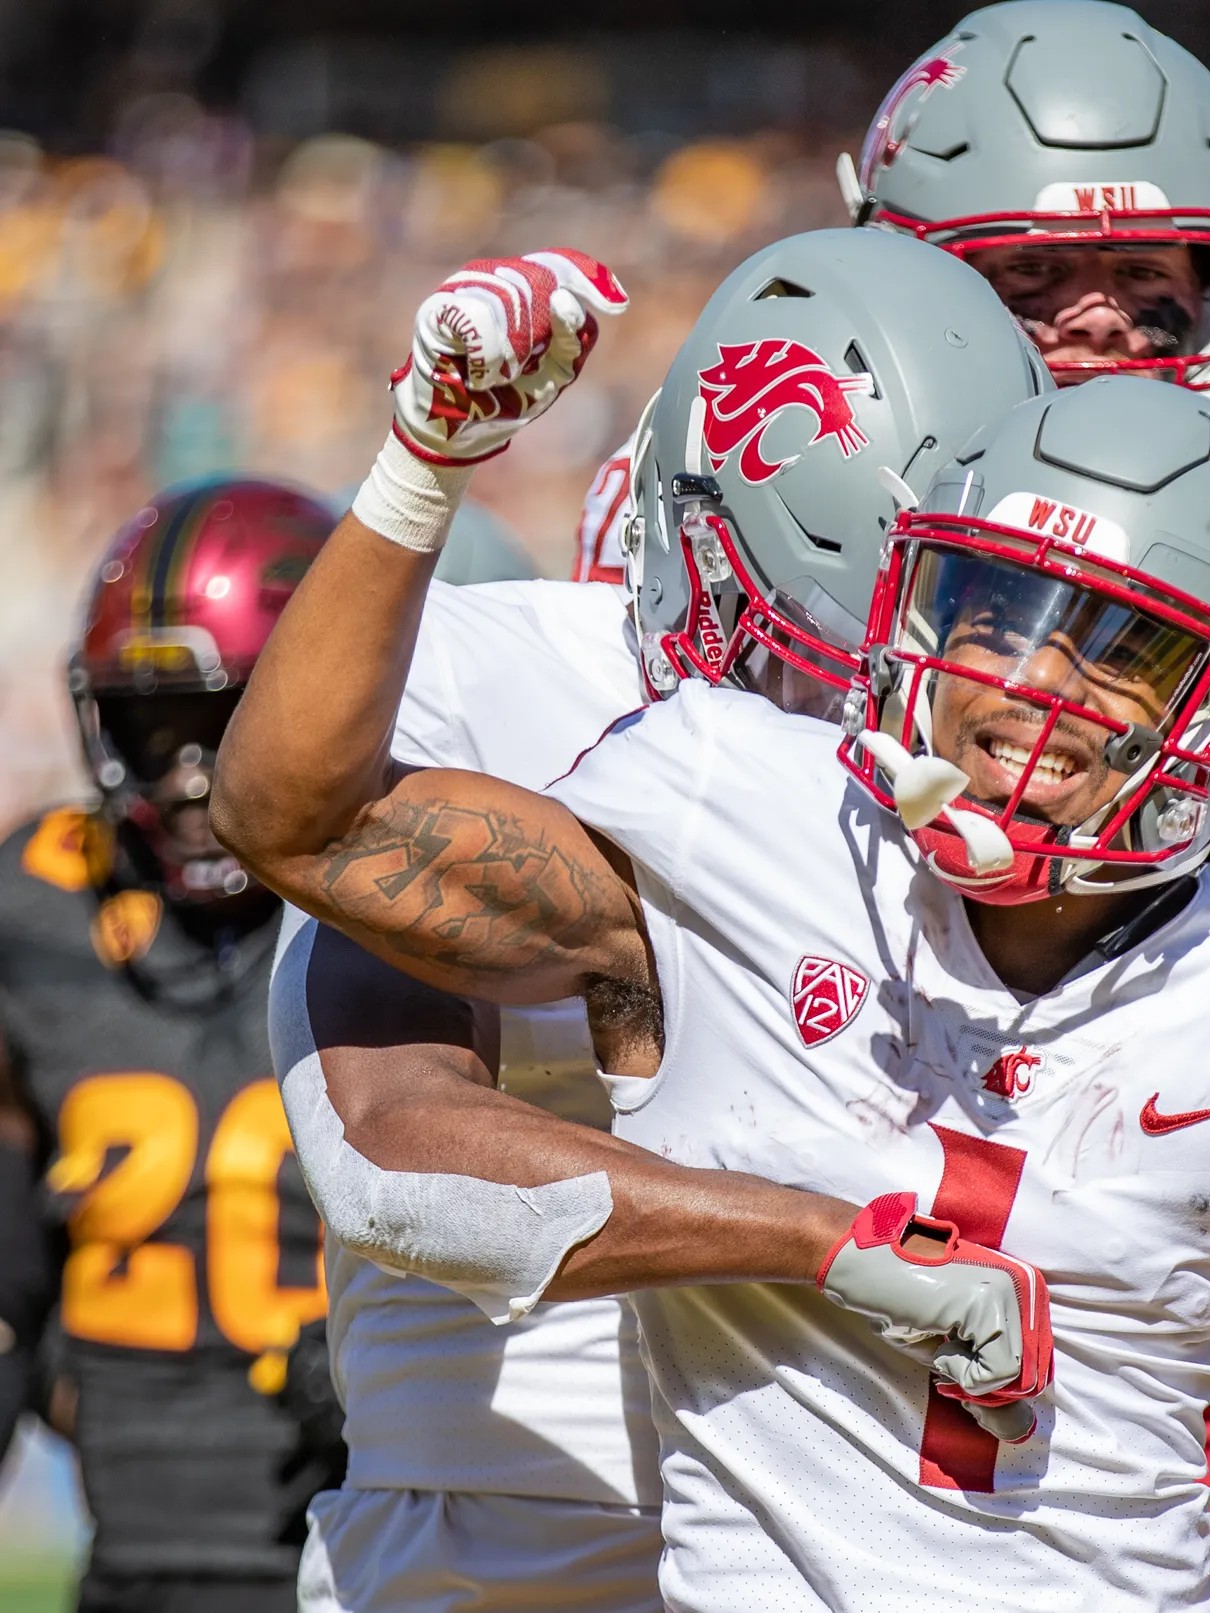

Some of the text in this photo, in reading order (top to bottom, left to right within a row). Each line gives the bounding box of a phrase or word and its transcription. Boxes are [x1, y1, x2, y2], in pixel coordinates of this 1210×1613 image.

[1073, 186, 1135, 211] WSU
[1028, 497, 1097, 546] WSU
[793, 956, 867, 1023] PAC
[798, 994, 839, 1034] 12
[58, 1073, 329, 1353] 20
